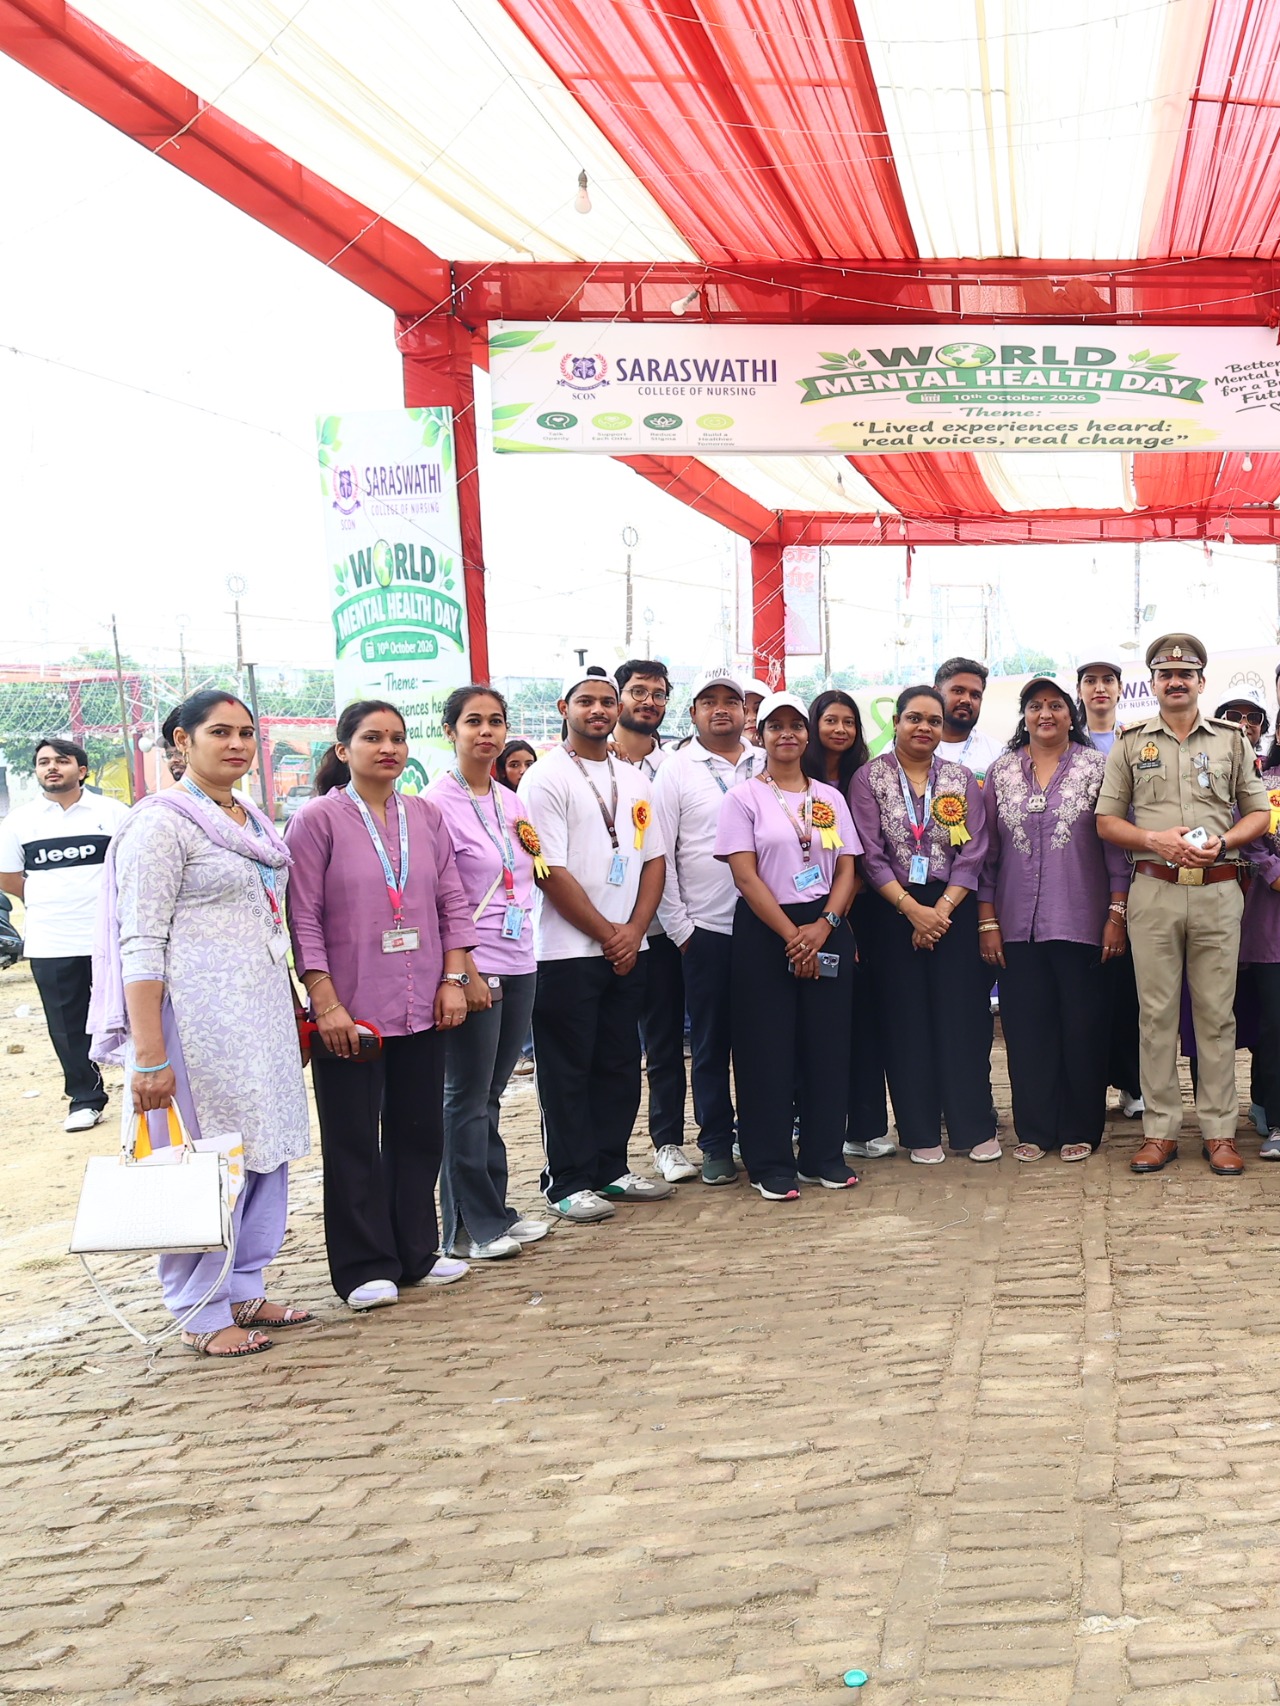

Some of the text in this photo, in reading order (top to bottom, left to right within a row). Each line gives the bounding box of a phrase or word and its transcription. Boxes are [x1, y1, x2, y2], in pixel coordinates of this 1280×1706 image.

[616, 358, 777, 383] SARASWATHI
[1214, 370, 1270, 386] Mental
[814, 370, 1193, 396] MENTAL HEALTH DAY
[638, 387, 756, 396] COLLEGE OF NURSING
[953, 393, 1086, 401] 10th October 2026
[1221, 385, 1247, 397] for
[959, 406, 1042, 417] Theme:
[942, 421, 1079, 435] experiences
[1086, 420, 1172, 432] heard:
[862, 434, 914, 446] real
[923, 434, 1005, 446] voices,
[1014, 433, 1068, 445] real
[365, 463, 442, 496] SARASWATHI
[371, 502, 440, 516] COLLEGE OF NURSING
[341, 519, 356, 531] SCON
[337, 592, 459, 640] MENTAL HEALTH DAY
[377, 640, 434, 655] 10th October 2026
[384, 672, 418, 692] Theme:
[1130, 700, 1158, 708] NURSIN
[34, 843, 97, 865] Jeep
